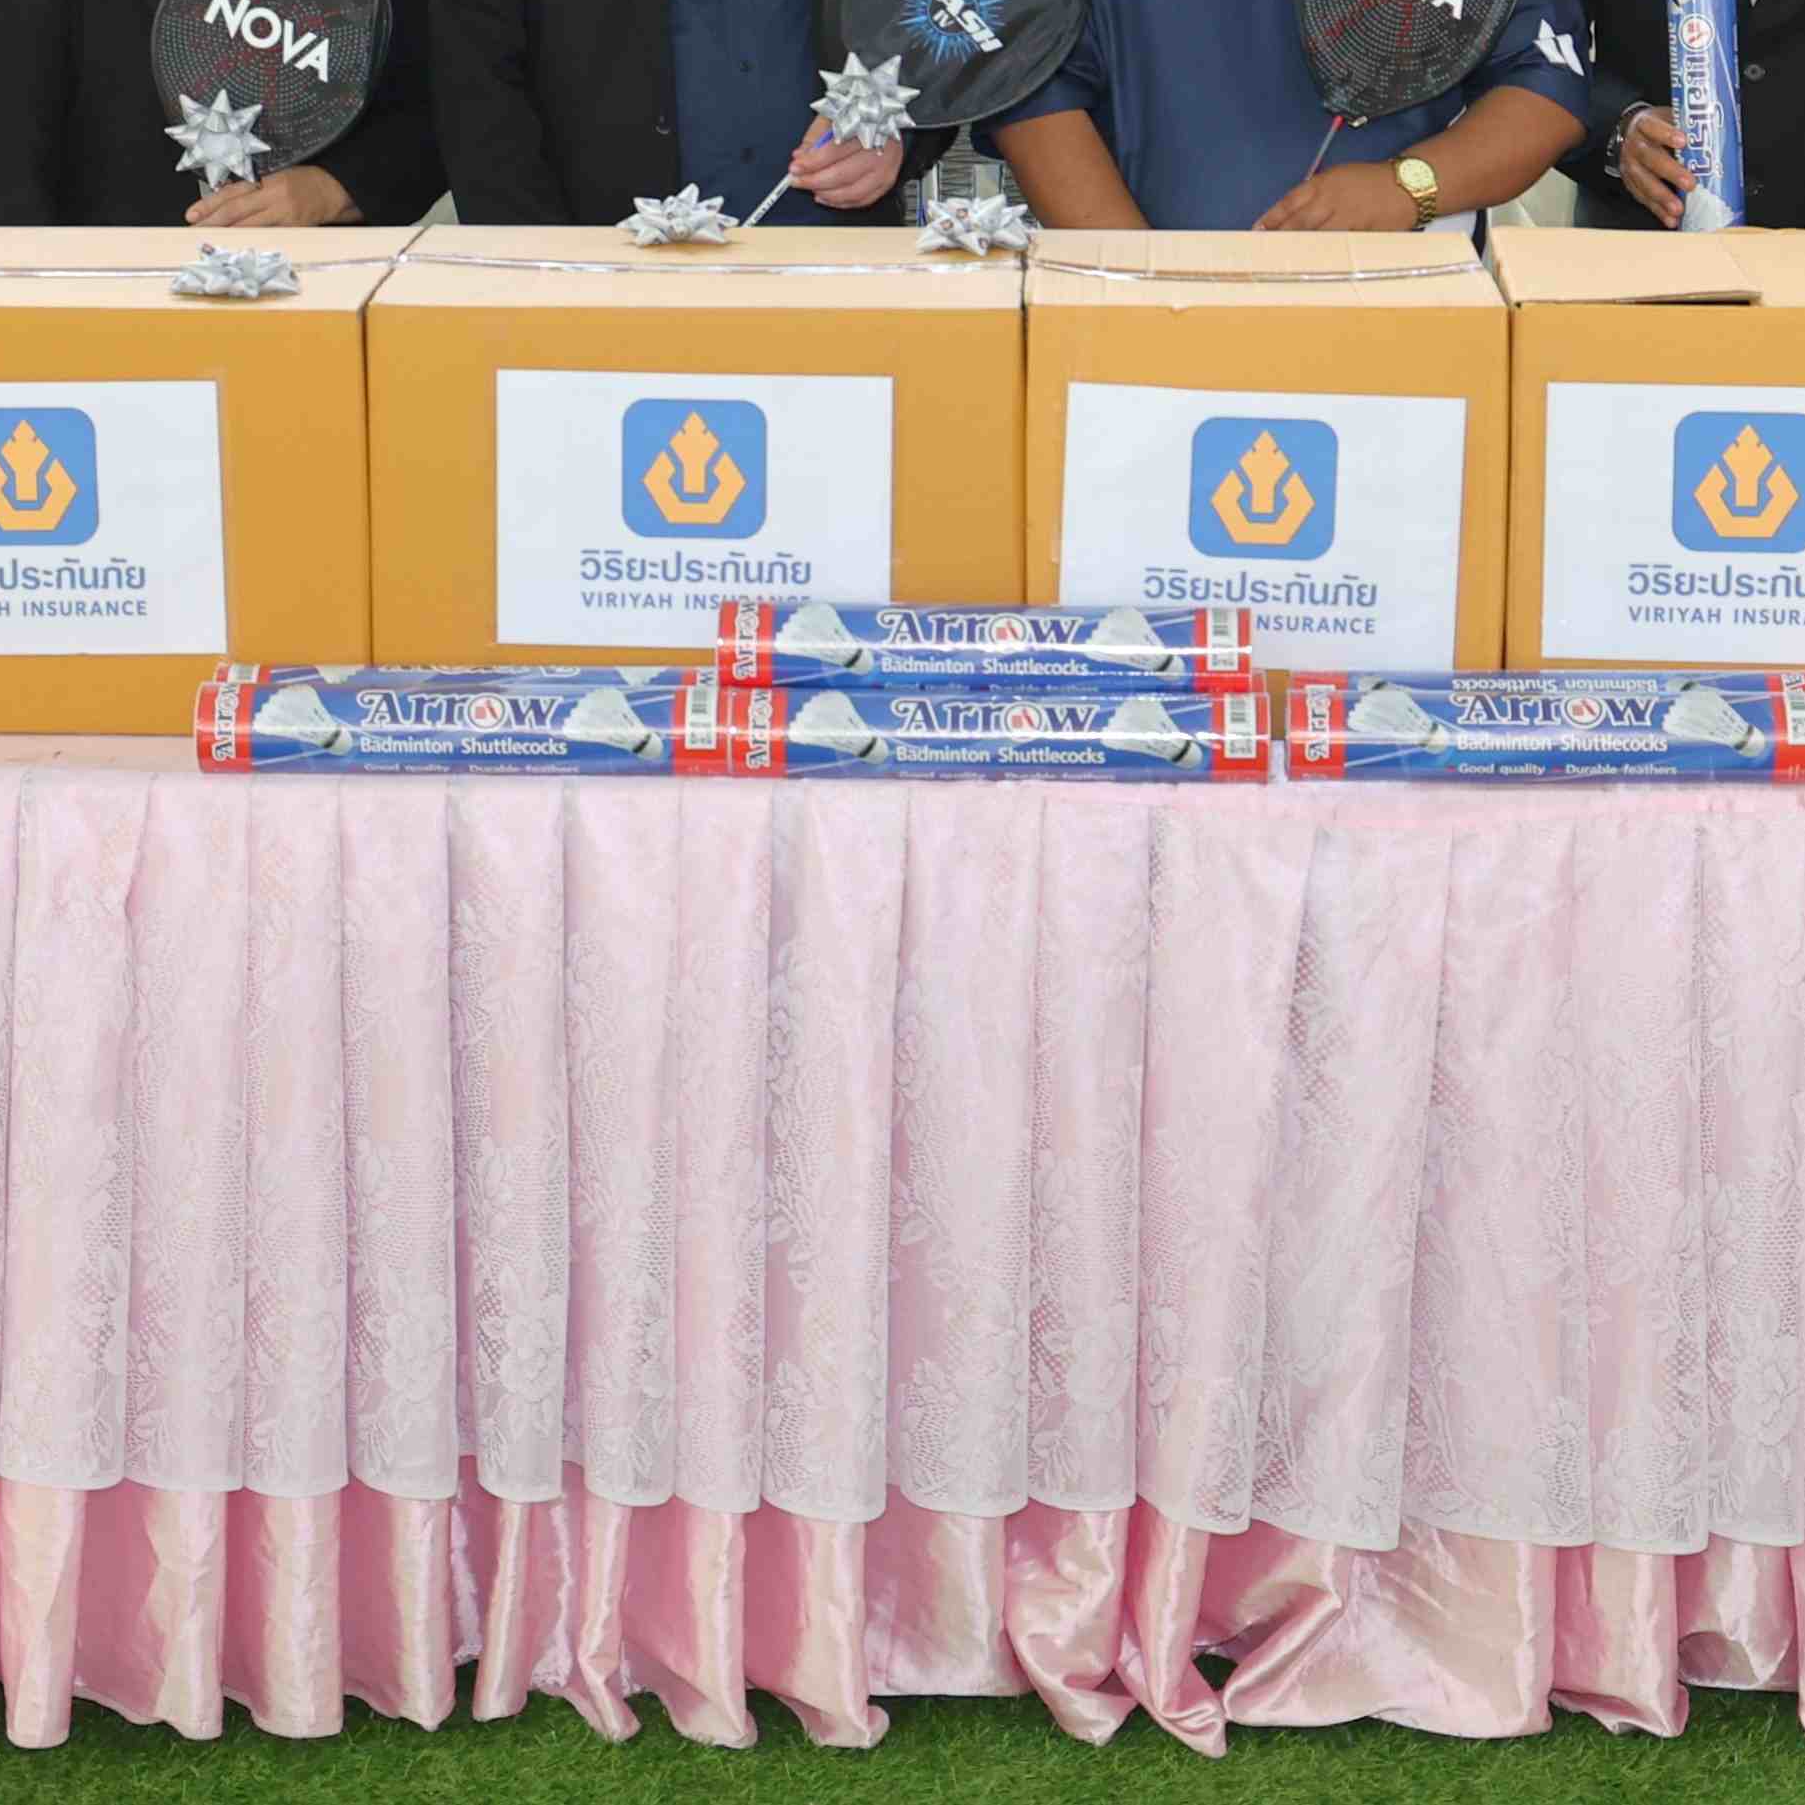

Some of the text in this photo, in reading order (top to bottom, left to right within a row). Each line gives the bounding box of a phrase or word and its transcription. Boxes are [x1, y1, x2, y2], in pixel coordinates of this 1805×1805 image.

[580, 549, 813, 586] วิริยะประกันภัย
[1143, 567, 1379, 608] วิริยะประกันภัย
[21, 599, 148, 617] INSURANCE
[581, 591, 673, 610] VIRIYAH
[1255, 614, 1377, 635] NSURANCE
[1628, 606, 1722, 625] VIRIYAH
[877, 610, 1085, 649] Arrow
[881, 656, 1089, 677] Badminton Shuttlecocks
[1451, 677, 1658, 694] Badminton Shuttlecocks
[356, 689, 565, 733] Arrow
[891, 698, 1099, 739] Arrow
[1449, 693, 1661, 730] Arrow
[359, 735, 568, 756] Badminton Shuttlecocks
[1456, 732, 1668, 752] Badminton Shuttlecocks
[895, 746, 1106, 765] Badminton Shuttlecocks
[1458, 761, 1678, 777] Good quality Durable feathers
